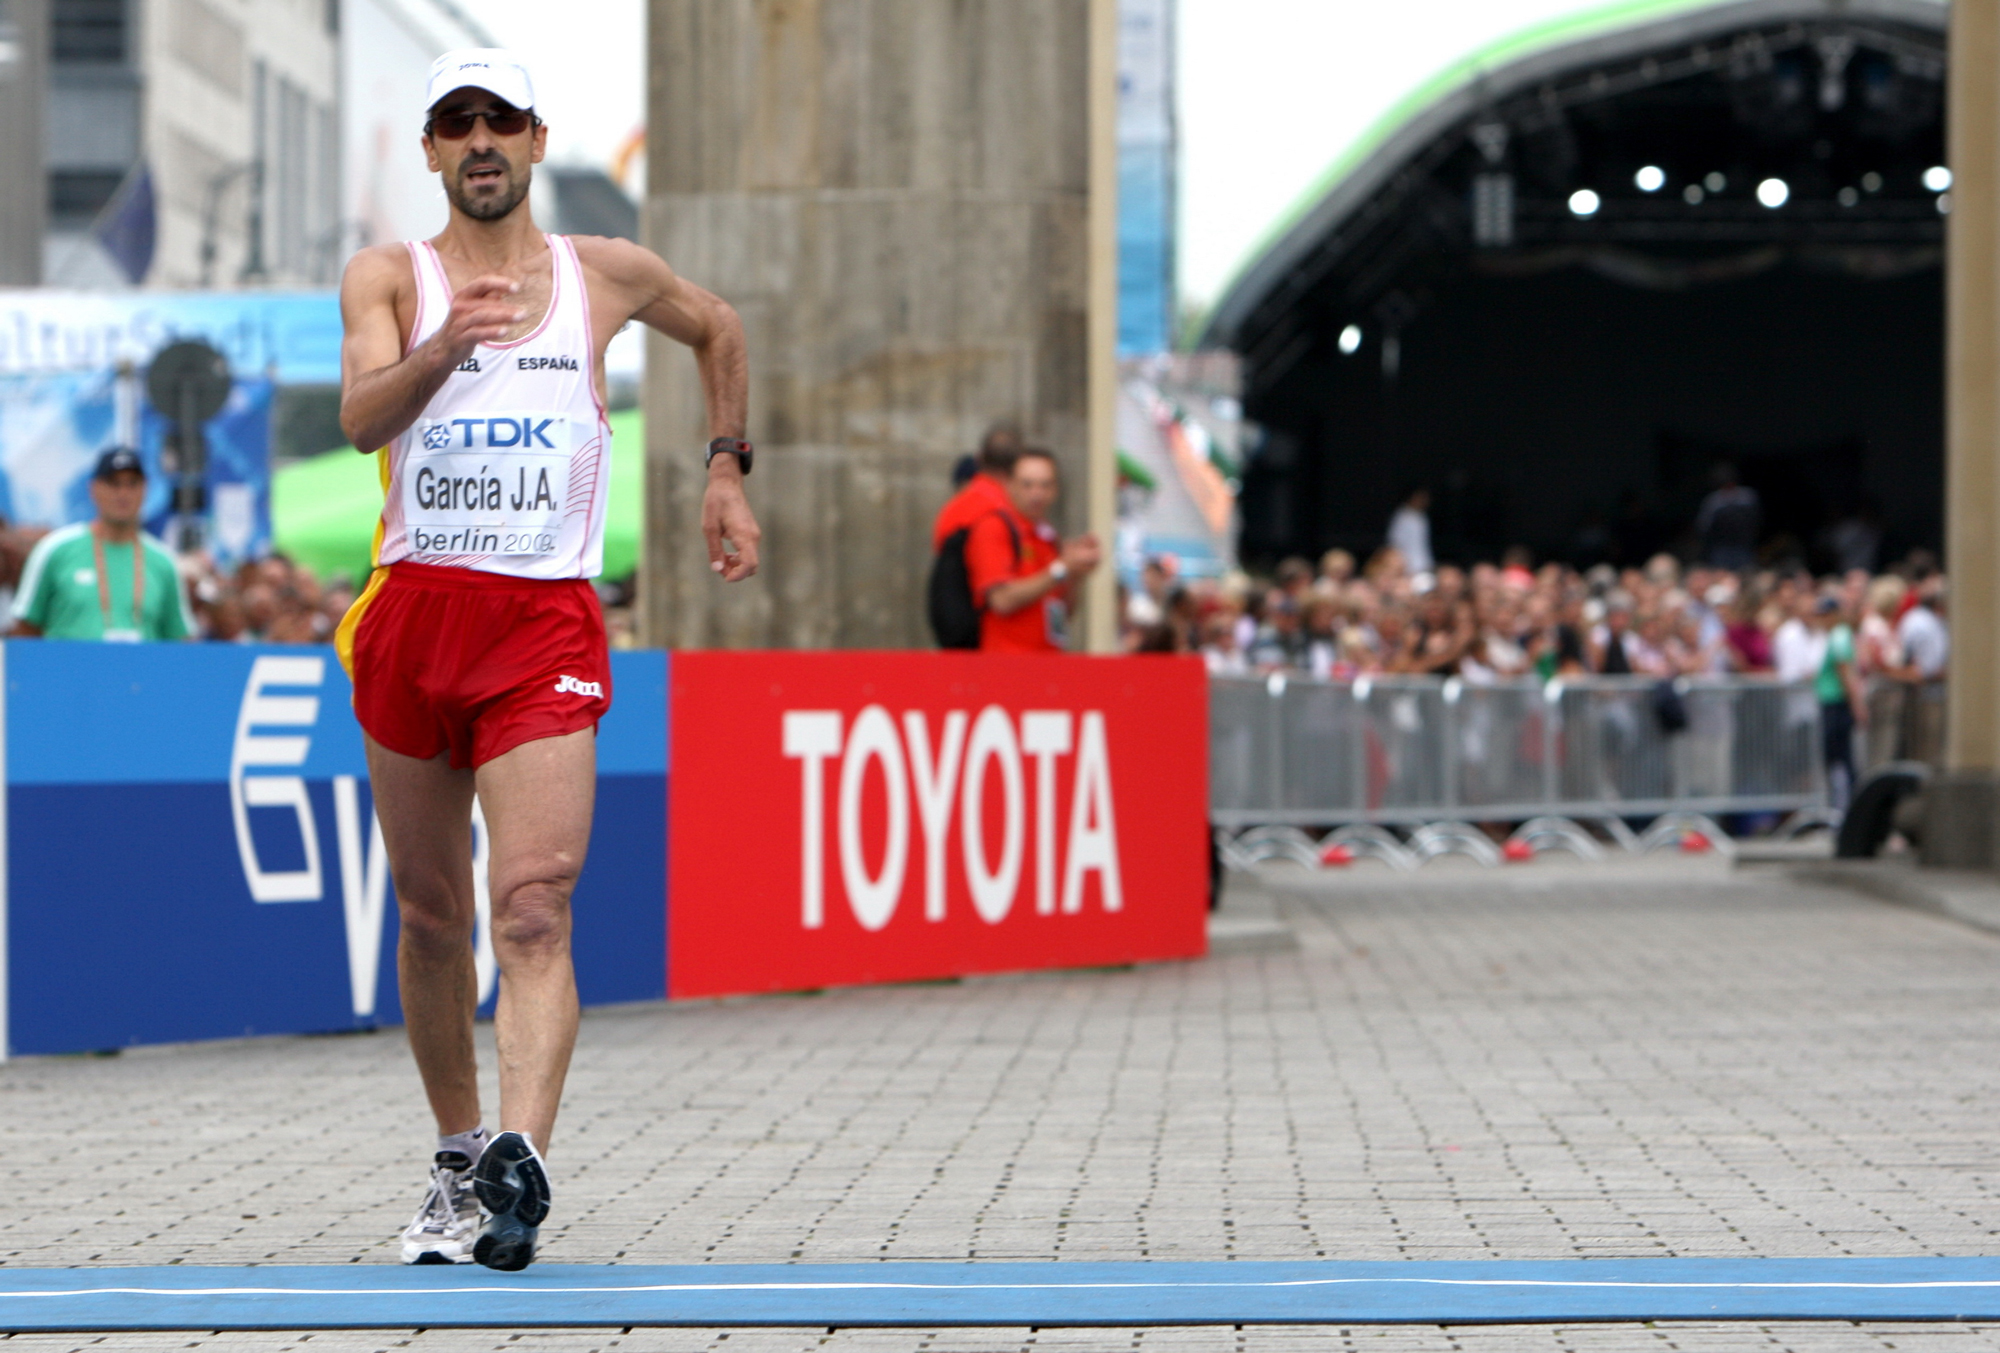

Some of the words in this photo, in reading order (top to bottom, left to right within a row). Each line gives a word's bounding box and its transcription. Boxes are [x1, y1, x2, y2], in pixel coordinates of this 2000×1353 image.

[518, 355, 579, 371] ESPAÑA
[452, 417, 556, 449] TDK
[416, 465, 501, 511] García
[511, 467, 557, 511] J.A.
[415, 528, 498, 551] berlin
[782, 704, 1123, 930] TOYOTA
